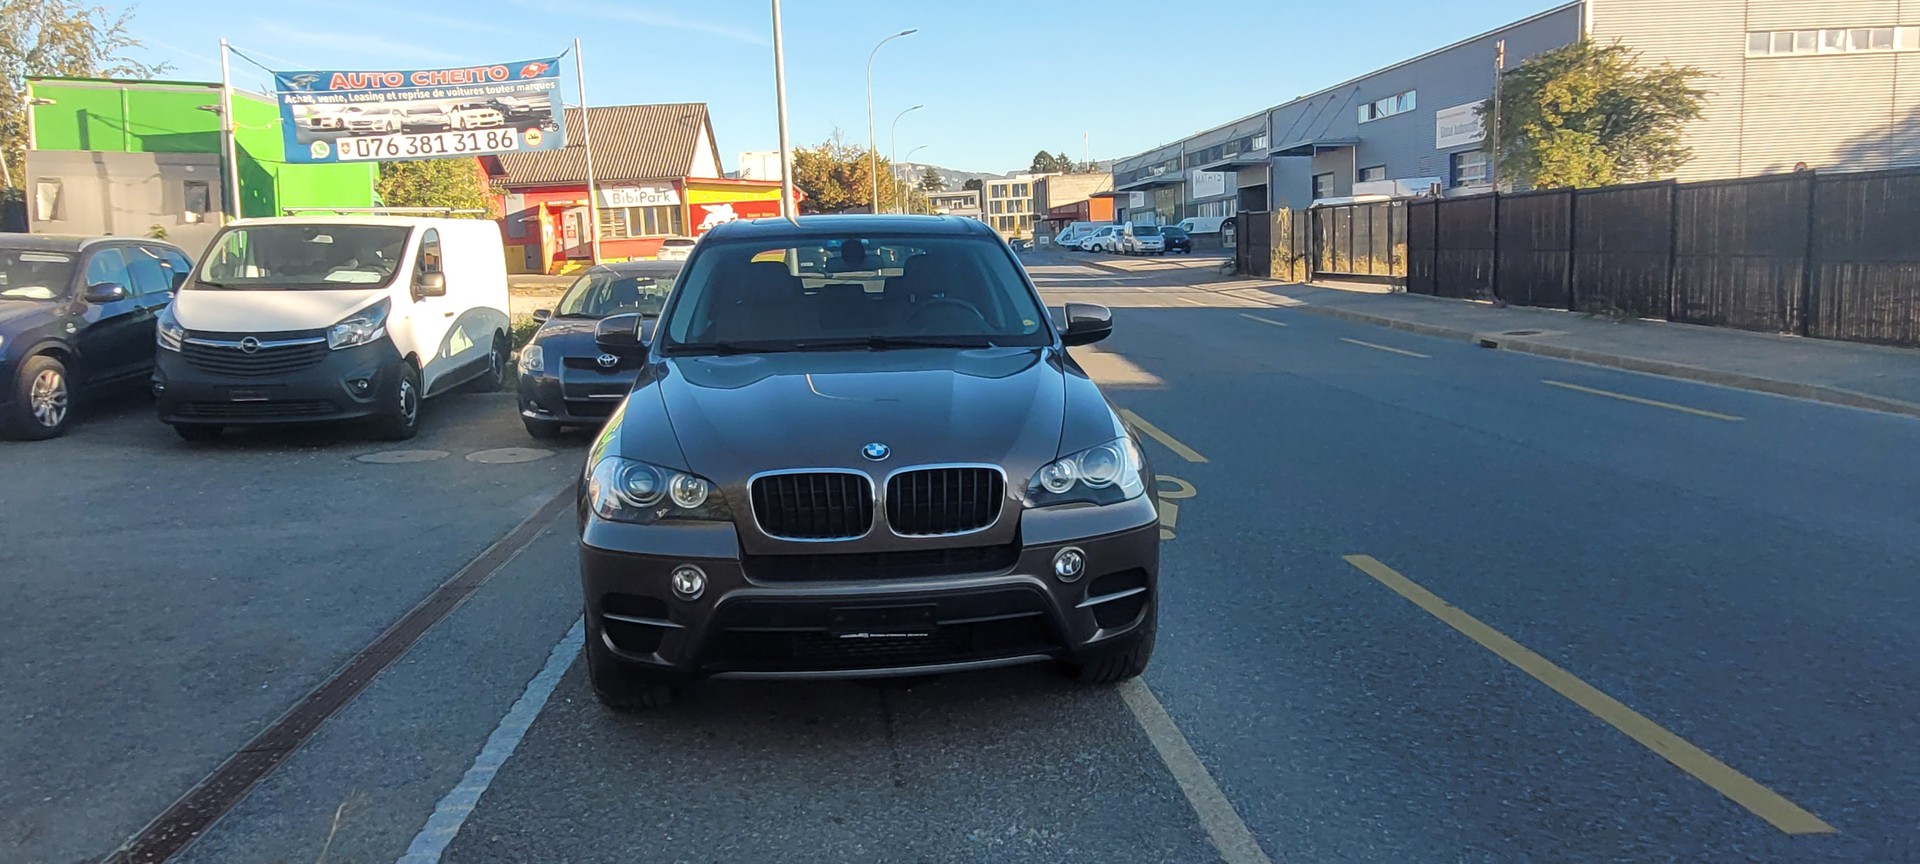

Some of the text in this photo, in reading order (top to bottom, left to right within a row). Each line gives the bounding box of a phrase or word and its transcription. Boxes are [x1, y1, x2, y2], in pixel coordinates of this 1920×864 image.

[329, 64, 510, 90] AUTO CHEITO
[284, 82, 556, 104] Achat, vente, Leasing et reprise de voitures toutes marques
[355, 130, 514, 158] 076 381 31 86
[612, 191, 671, 204] BibiPark
